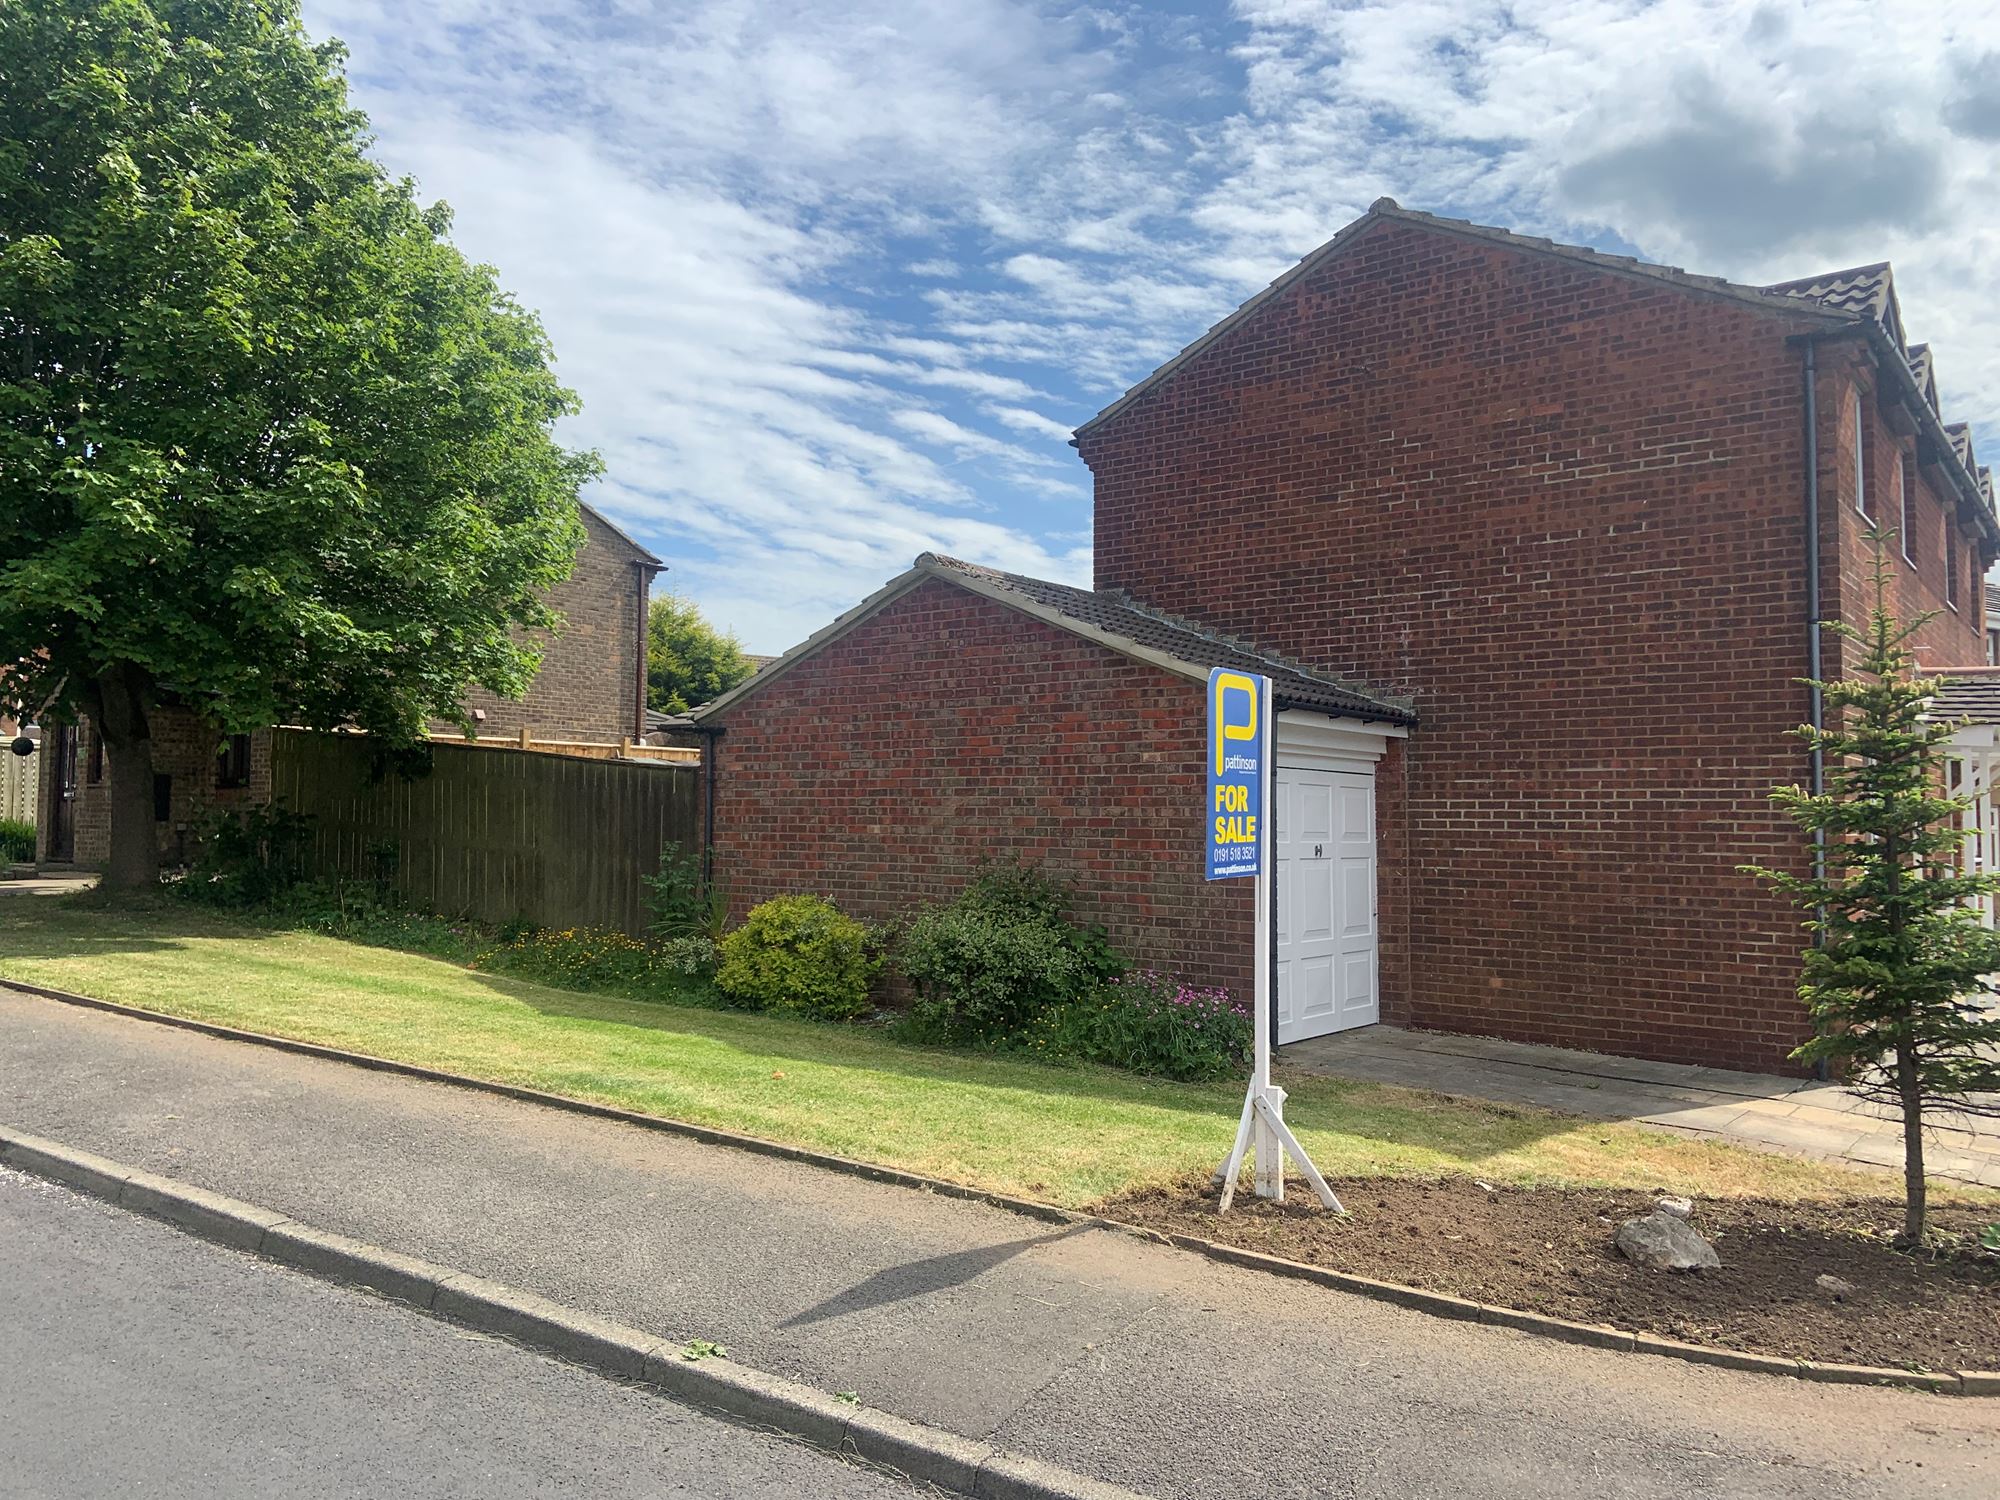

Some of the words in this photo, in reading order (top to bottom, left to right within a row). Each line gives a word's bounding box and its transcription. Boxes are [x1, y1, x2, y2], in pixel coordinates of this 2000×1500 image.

[1225, 755, 1257, 772] pattinson
[1215, 784, 1249, 812] FOR
[1215, 816, 1256, 844] SALE
[1214, 848, 1229, 862] 0191
[1229, 847, 1241, 861] 518
[1241, 846, 1255, 860] 3521
